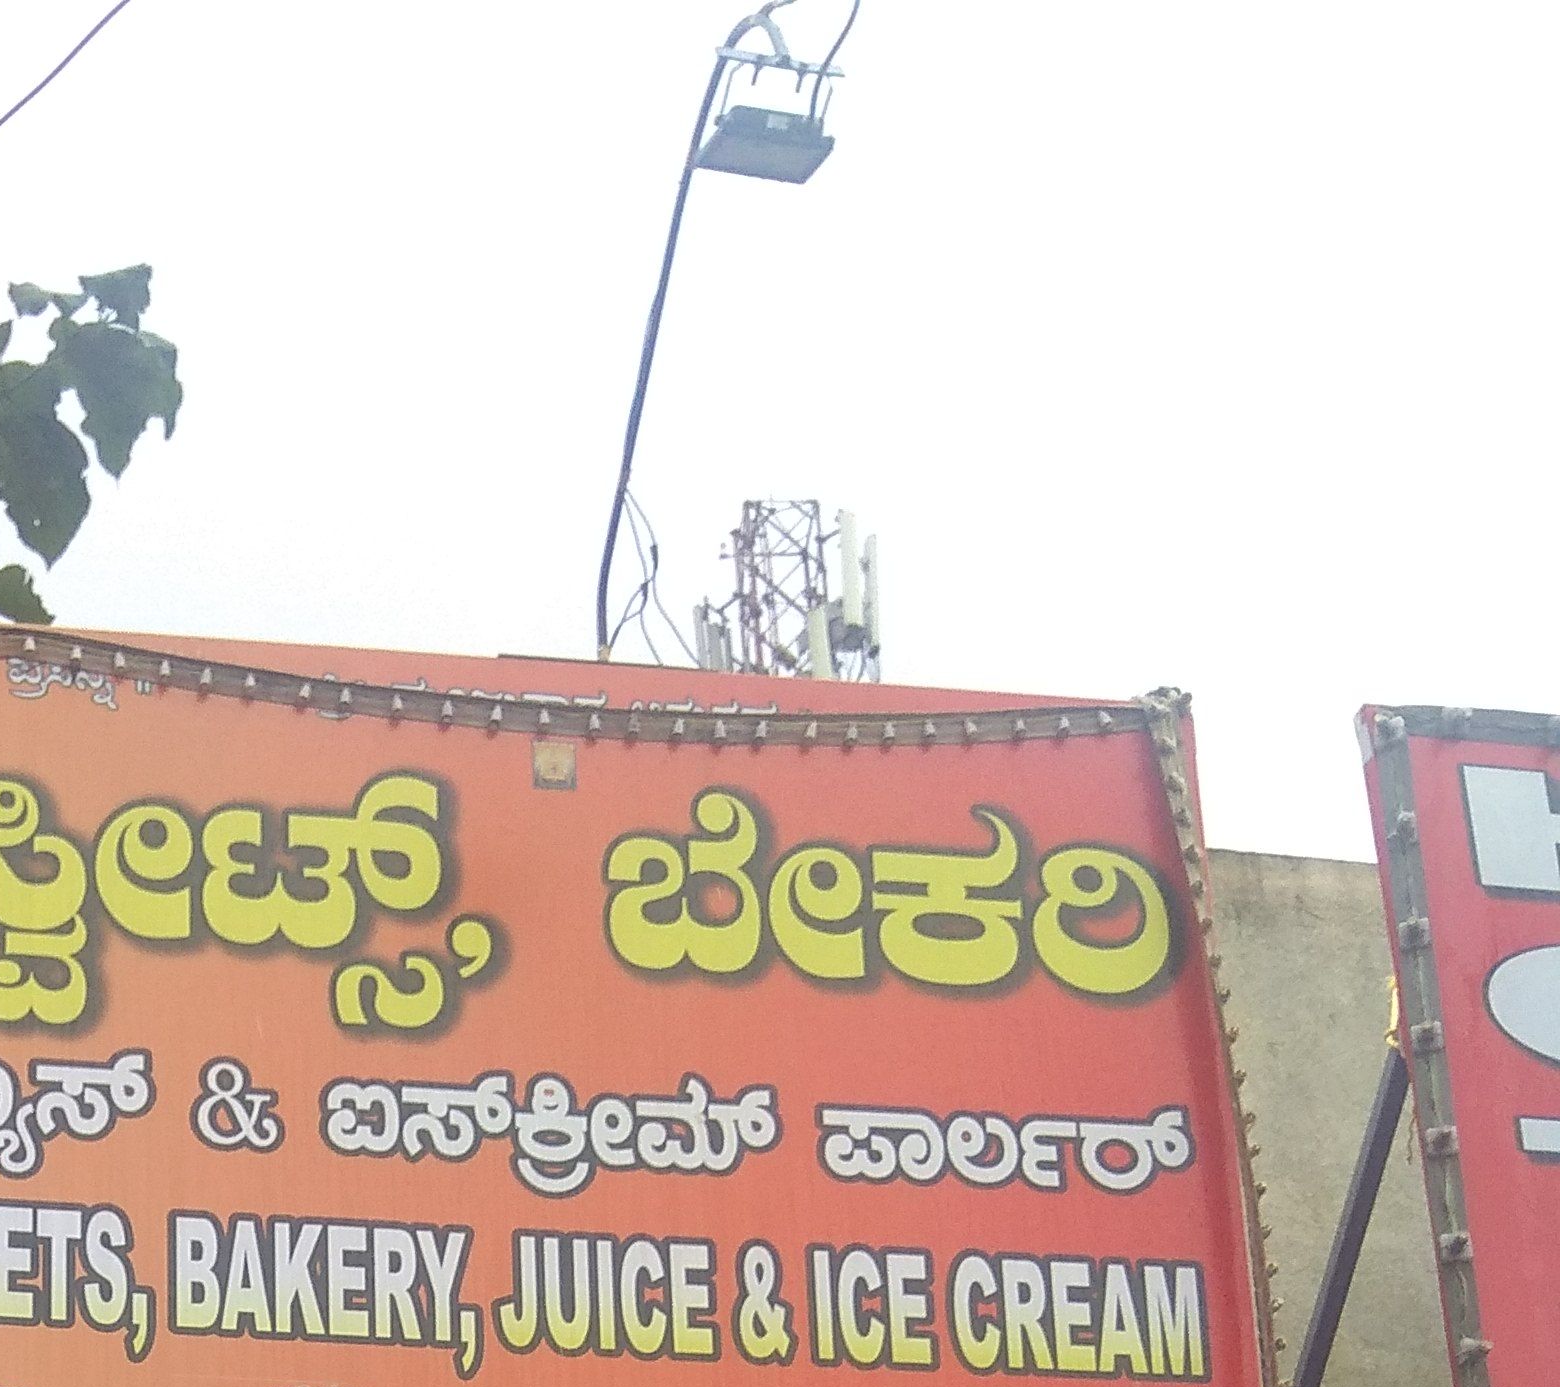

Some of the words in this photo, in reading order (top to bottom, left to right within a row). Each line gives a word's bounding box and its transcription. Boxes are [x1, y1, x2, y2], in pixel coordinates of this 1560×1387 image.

[605, 790, 1171, 996] ಬೇಕರಿ
[194, 1059, 281, 1150] &
[817, 1105, 1192, 1192] ಪಾರ್ಲರ್
[172, 1211, 478, 1376] BAKERY,
[495, 1233, 718, 1357] JUICE
[737, 1241, 793, 1364] &
[811, 1248, 936, 1368] ICE
[951, 1254, 1208, 1379] CREAM
